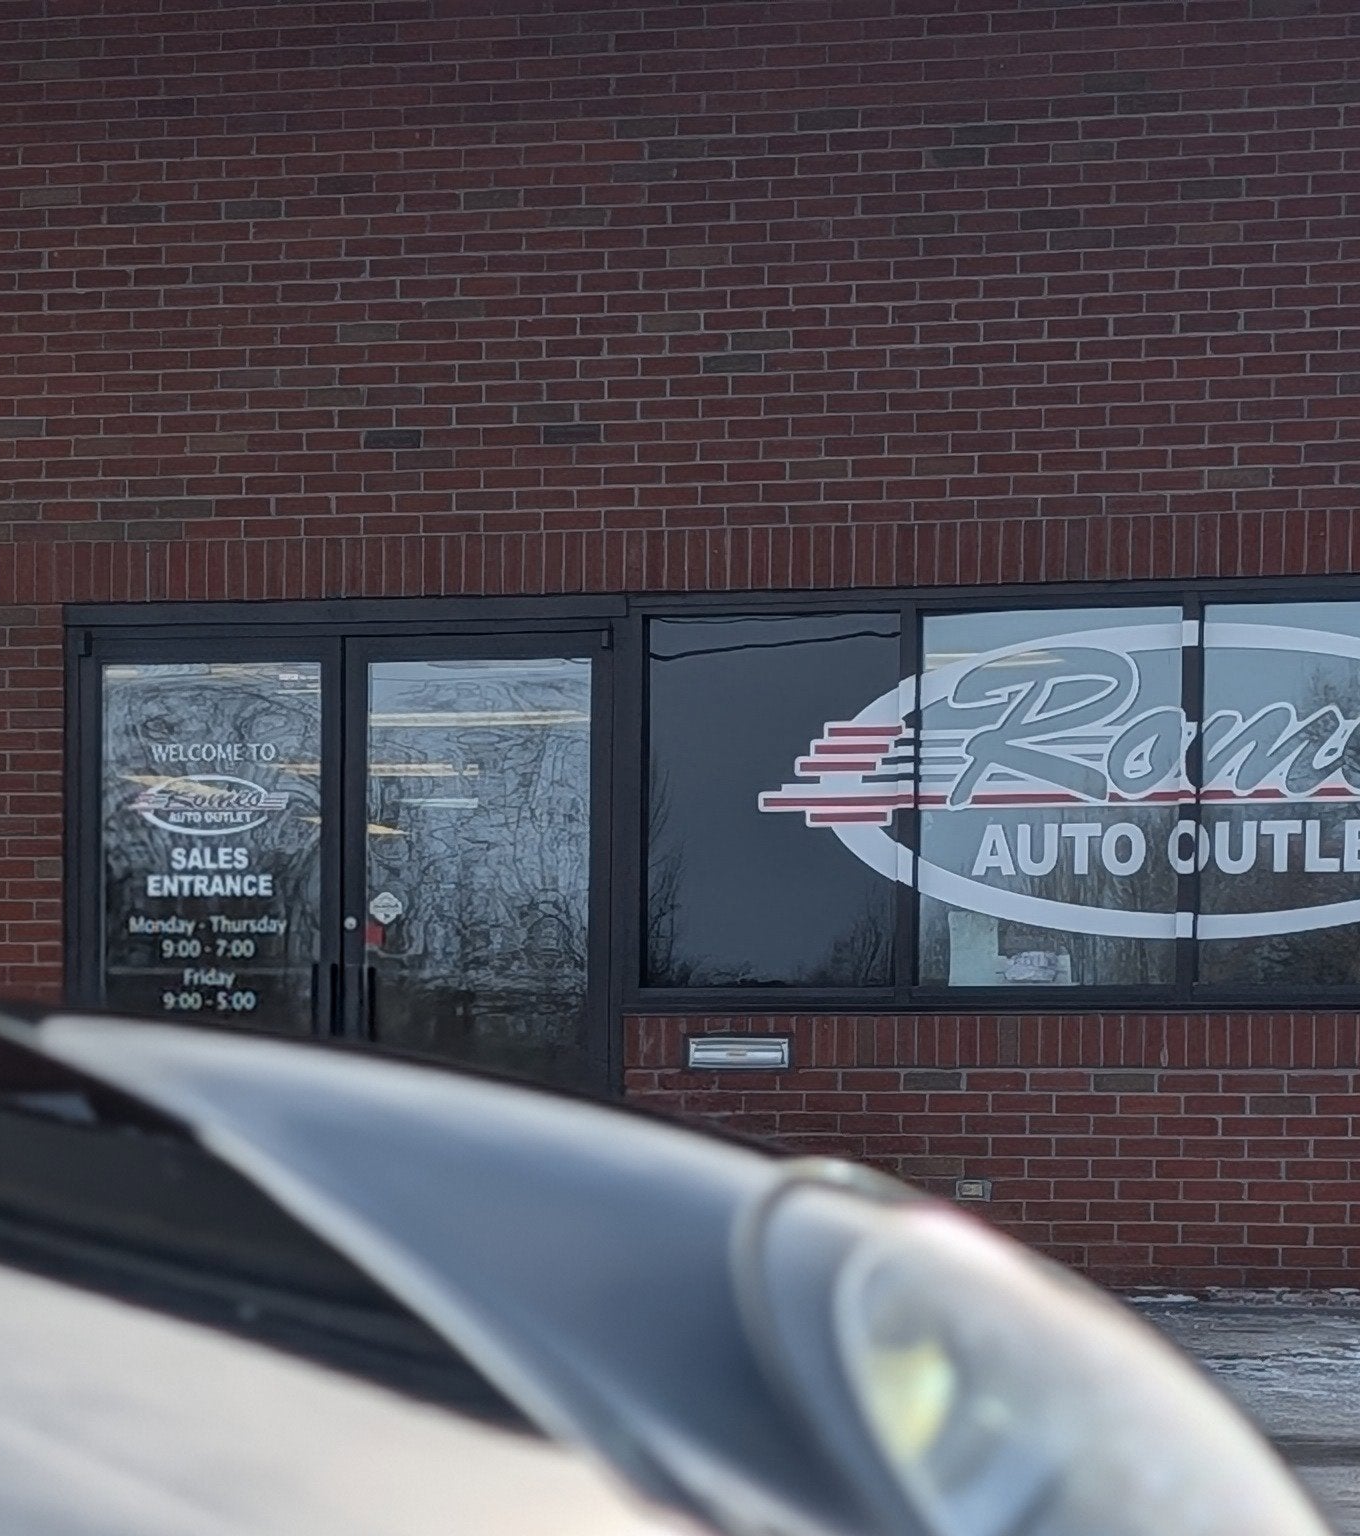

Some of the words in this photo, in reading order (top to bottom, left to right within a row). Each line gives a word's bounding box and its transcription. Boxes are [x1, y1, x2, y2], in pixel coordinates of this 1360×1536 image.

[150, 743, 244, 762] WELCOME
[247, 743, 277, 762] TO
[168, 811, 202, 823] AUTO
[203, 811, 253, 823] OUTLET
[170, 847, 250, 870] SALES
[971, 820, 1148, 877] AUTO
[146, 873, 274, 898] ENTRANCE
[128, 915, 196, 936] Monday
[209, 915, 288, 936] Thursday
[161, 938, 202, 958] 9:00
[215, 938, 256, 958] 7:00
[183, 967, 236, 989] Friday
[162, 991, 203, 1010] 9:00
[216, 991, 257, 1010] 5:00
